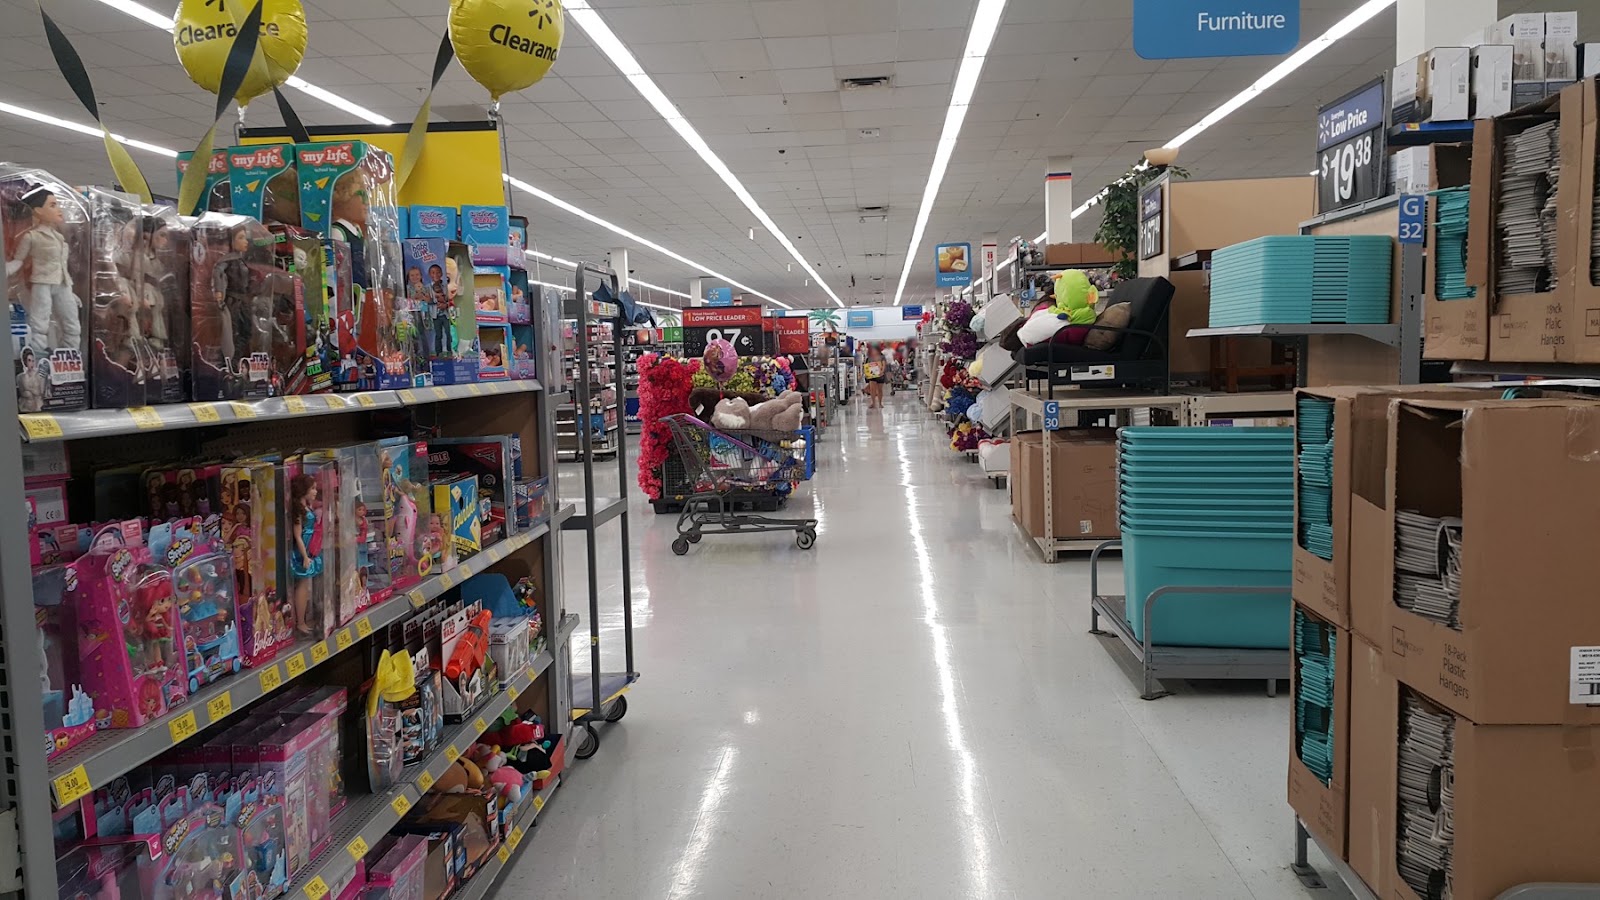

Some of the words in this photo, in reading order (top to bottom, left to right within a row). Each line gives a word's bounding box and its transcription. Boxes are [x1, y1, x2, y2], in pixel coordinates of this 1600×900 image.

[1198, 11, 1286, 31] Furniture
[178, 22, 279, 47] Clearace
[489, 24, 557, 61] Clearanc
[1331, 119, 1347, 138] Low
[1348, 109, 1368, 131] Price
[1403, 198, 1419, 216] G
[1400, 222, 1422, 239] 32
[52, 350, 80, 361] STAR
[251, 355, 268, 363] STAR
[52, 361, 82, 373] WARS
[251, 361, 269, 371] WARS
[1046, 403, 1056, 413] G
[1045, 418, 1058, 428] 30
[428, 452, 448, 462] UBLE
[253, 627, 275, 657] Barbie
[1444, 643, 1467, 663] 18-Pack
[1443, 657, 1466, 680] Plastic
[1439, 672, 1469, 699] Hangers
